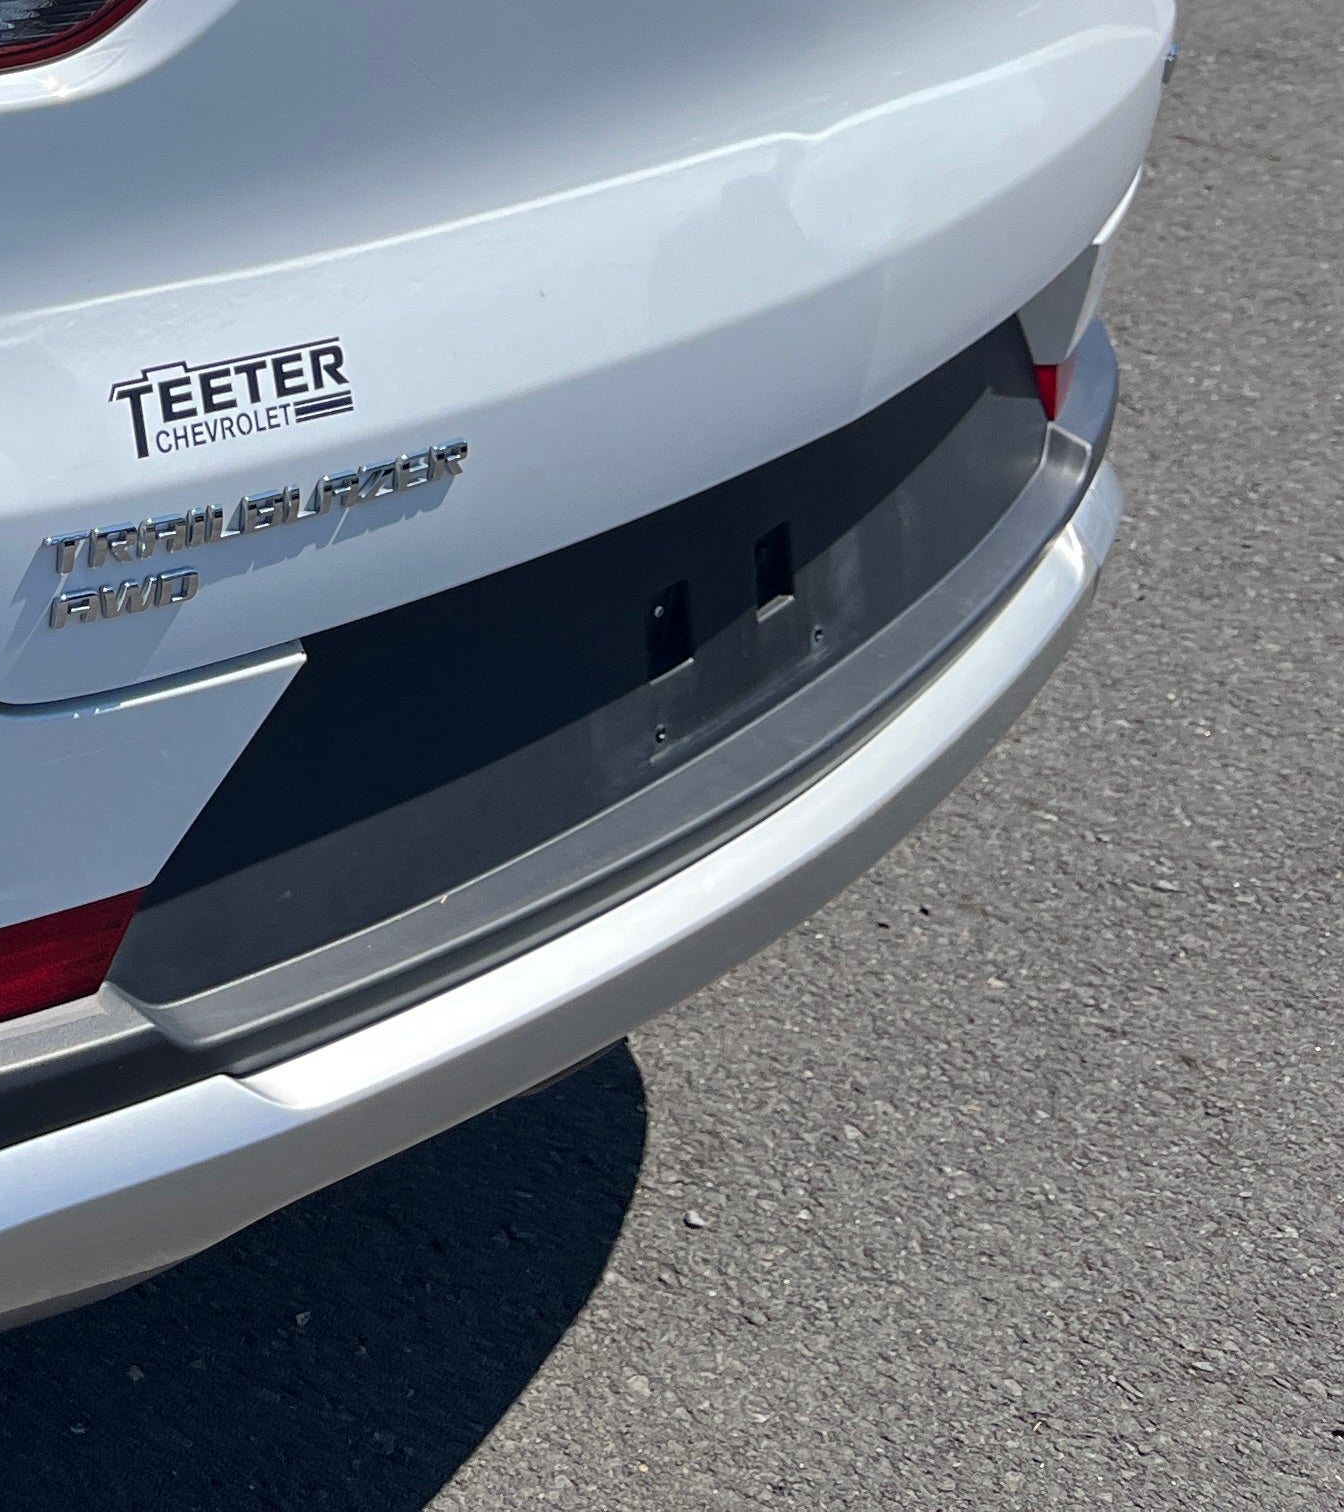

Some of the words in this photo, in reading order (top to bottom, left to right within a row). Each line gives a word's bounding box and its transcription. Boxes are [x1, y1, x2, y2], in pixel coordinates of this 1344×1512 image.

[115, 344, 350, 459] TEETER
[155, 403, 295, 455] CHEVROLET
[43, 437, 469, 576] TRAILBLAZER
[48, 566, 200, 630] AWD
